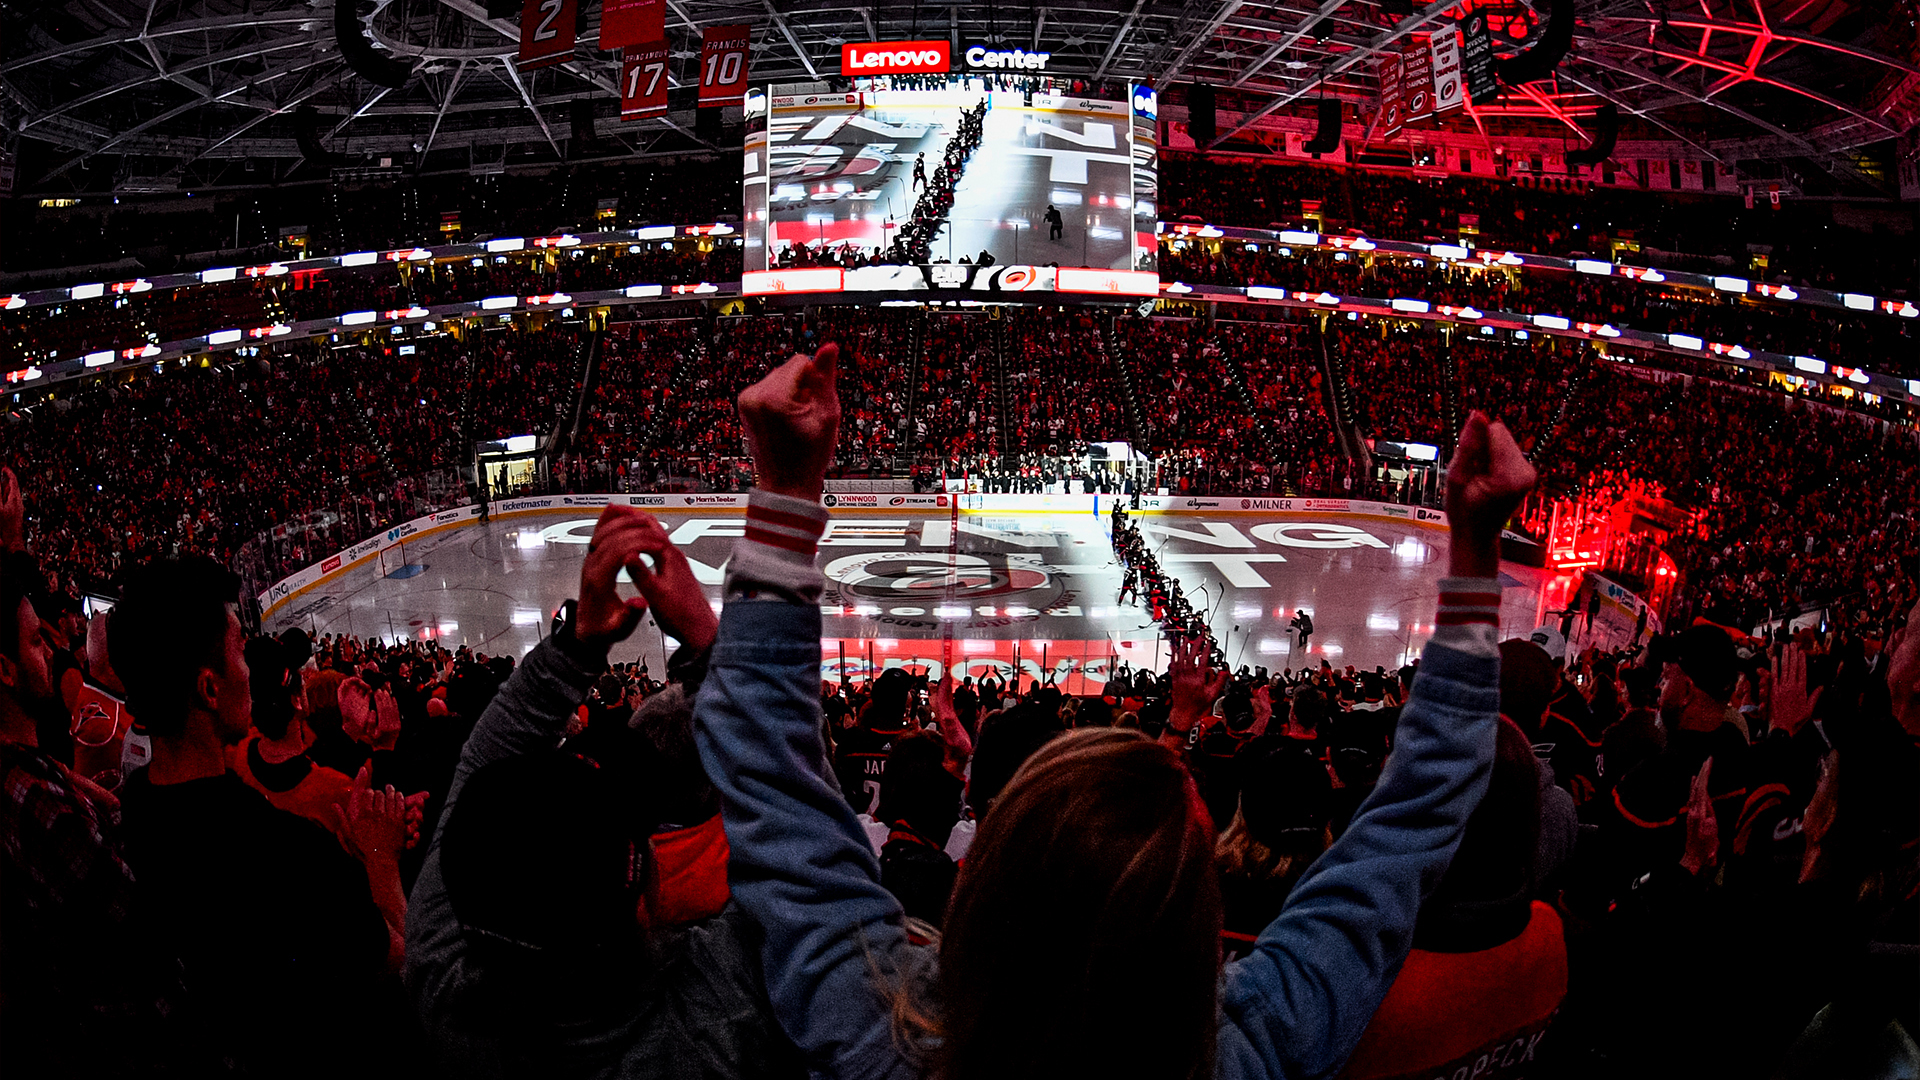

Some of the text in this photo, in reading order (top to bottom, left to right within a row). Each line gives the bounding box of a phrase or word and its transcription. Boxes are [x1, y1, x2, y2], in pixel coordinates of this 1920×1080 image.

[533, 0, 563, 42] 2
[706, 38, 747, 51] FRANCIS
[850, 49, 941, 69] Lenovo
[965, 45, 1050, 71] Center
[705, 52, 743, 86] 10
[627, 62, 664, 99] 17
[502, 499, 552, 511] ticketmaster
[695, 496, 737, 504] Harris Teeter
[837, 495, 877, 503] LYNNWOOD
[1187, 498, 1220, 510] Wegmans
[1252, 499, 1292, 509] MILNER
[436, 512, 459, 522] Fanatics
[322, 558, 340, 571] Lenovo
